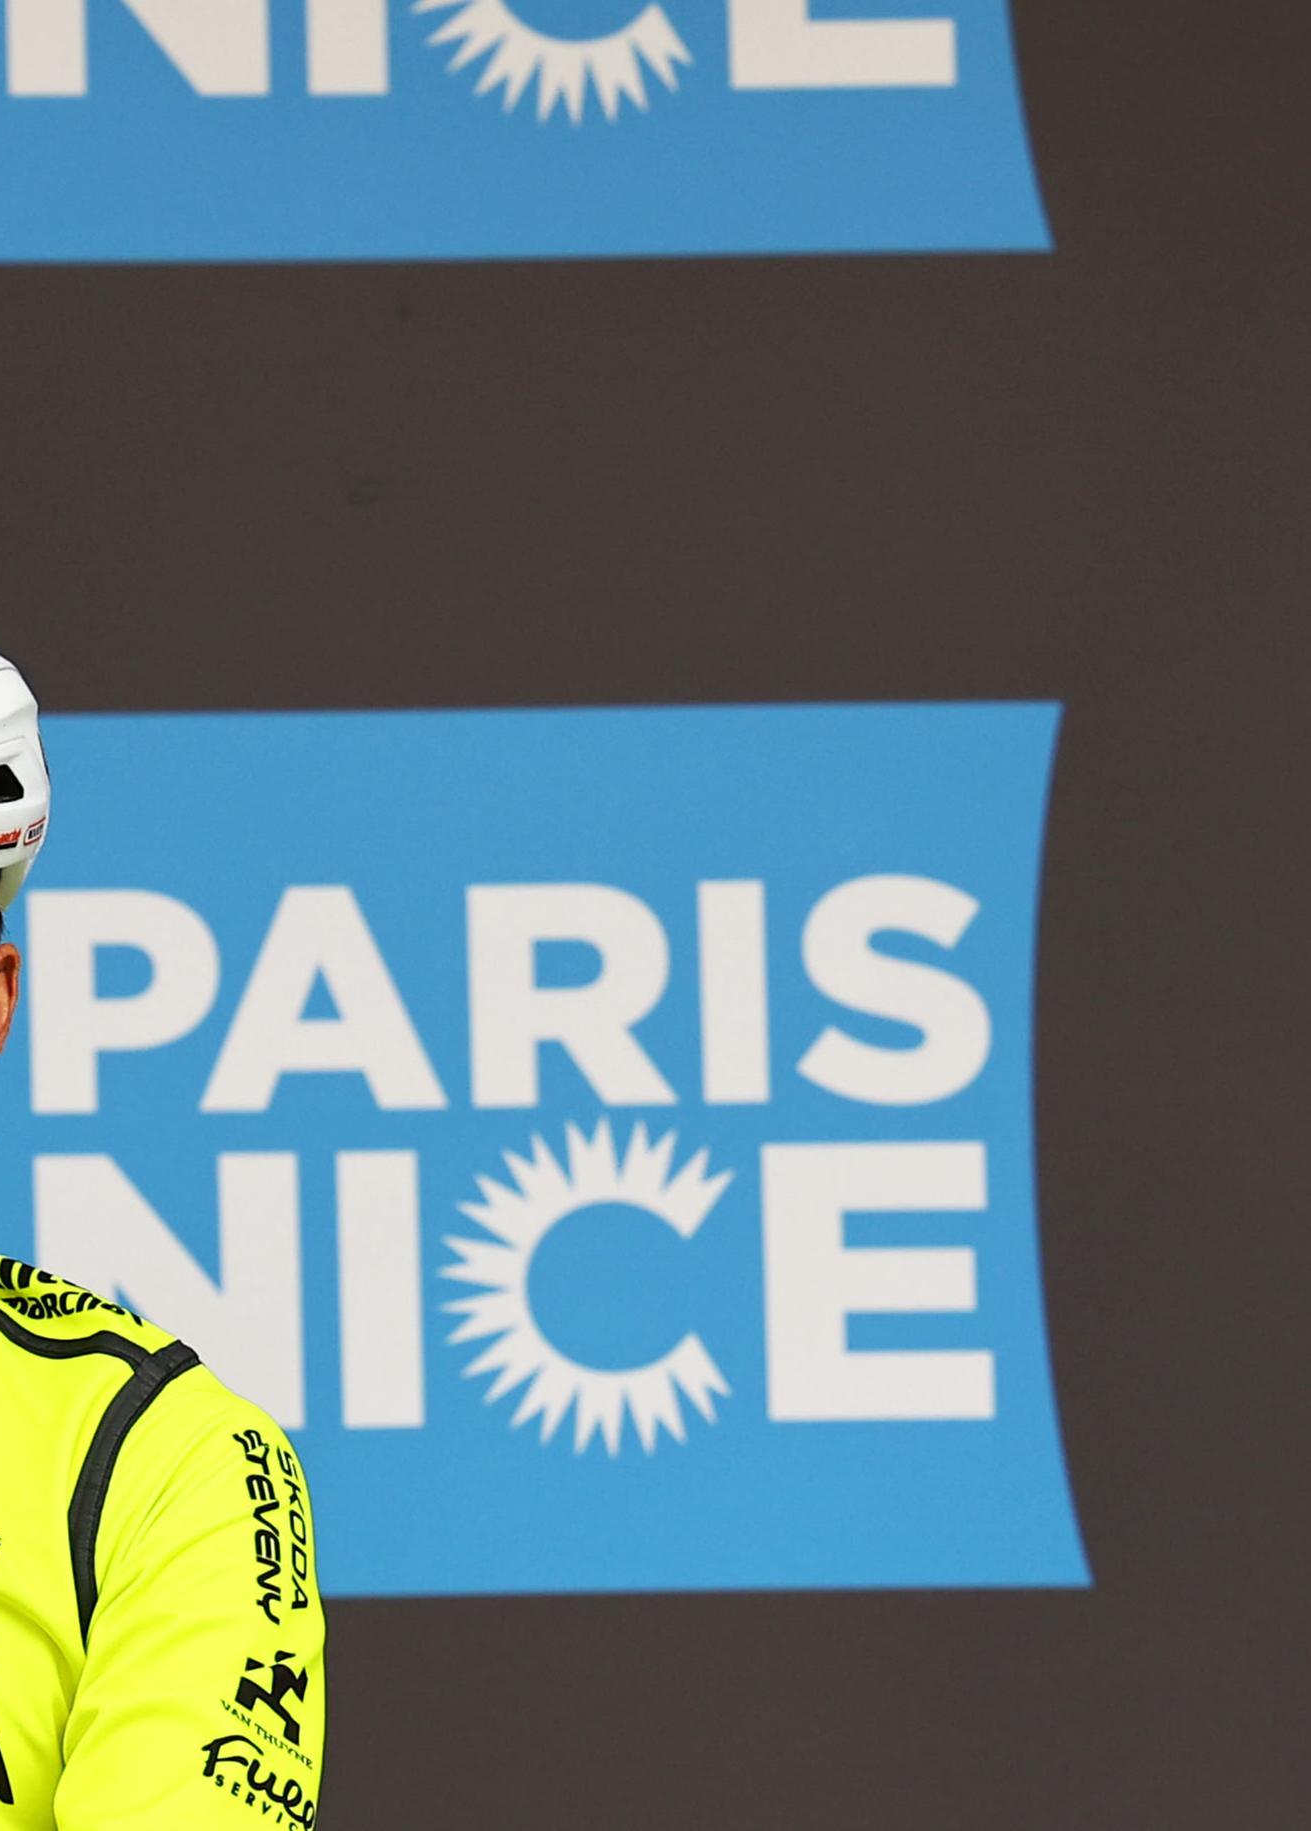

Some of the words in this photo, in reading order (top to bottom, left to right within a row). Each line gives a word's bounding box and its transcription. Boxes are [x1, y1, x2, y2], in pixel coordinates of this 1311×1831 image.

[25, 874, 992, 1116] PARIS
[32, 1115, 996, 1459] NICE
[277, 1445, 309, 1610] SKODA
[220, 1699, 251, 1728] VAN
